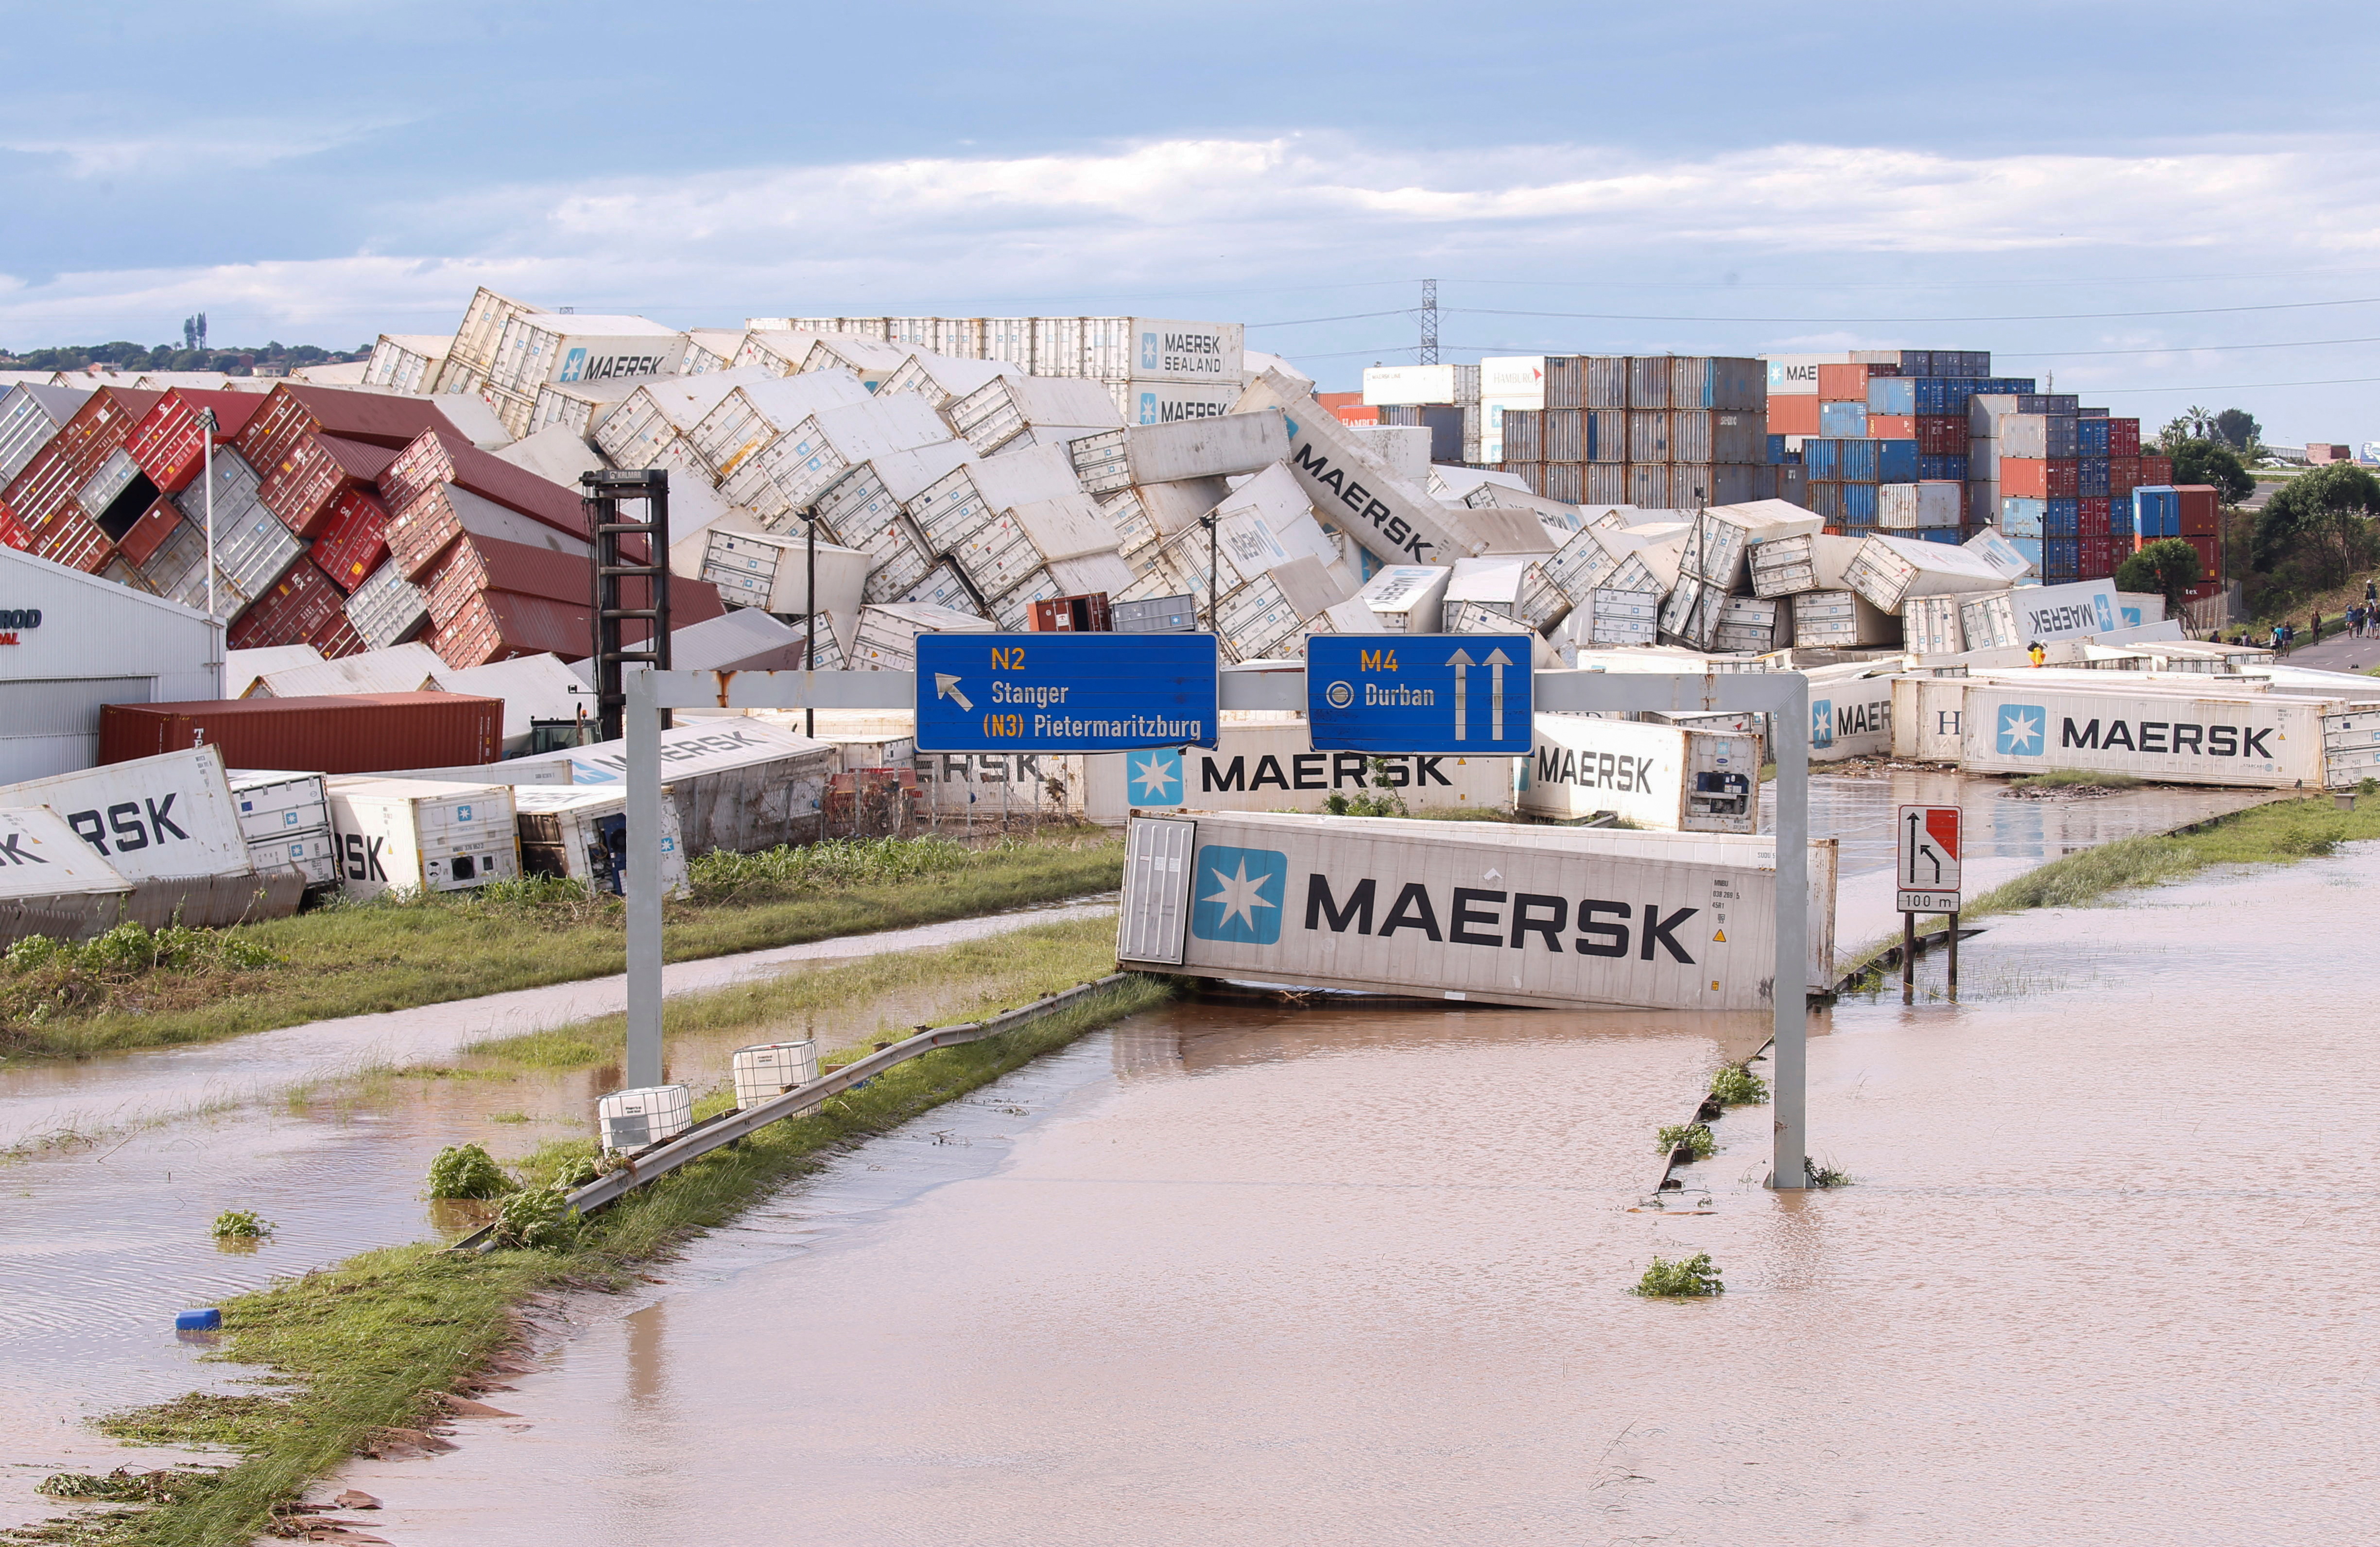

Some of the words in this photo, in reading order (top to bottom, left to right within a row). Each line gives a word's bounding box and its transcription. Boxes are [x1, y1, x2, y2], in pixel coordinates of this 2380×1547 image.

[1165, 333, 1220, 354] MAERSK
[583, 356, 665, 380] MAERSK
[1165, 356, 1221, 373] SEALAND
[1787, 365, 1817, 380] MAE
[1493, 372, 1535, 384] HAMBURG
[1161, 401, 1227, 423] MAERSK
[1293, 443, 1435, 565] MAERSK
[1224, 529, 1271, 562] MAERSK
[1369, 577, 1420, 605] MAERSK
[2028, 603, 2095, 635] MAERSK
[0, 633, 20, 645] AL
[992, 648, 1025, 670] N2
[1361, 649, 1398, 672] M4
[992, 681, 1069, 709] Stanger
[1365, 683, 1434, 706] Durban
[983, 714, 1024, 738] (N3)
[1034, 714, 1201, 741] Pietermaritzburg
[2062, 717, 2275, 759] MAERSK
[1202, 753, 1453, 792] MAERSK
[1538, 745, 1654, 794] MAERSK
[67, 792, 191, 857] RSK
[1906, 894, 1931, 907] 100
[1939, 898, 1951, 908] m
[1305, 873, 1700, 965] MAERSK
